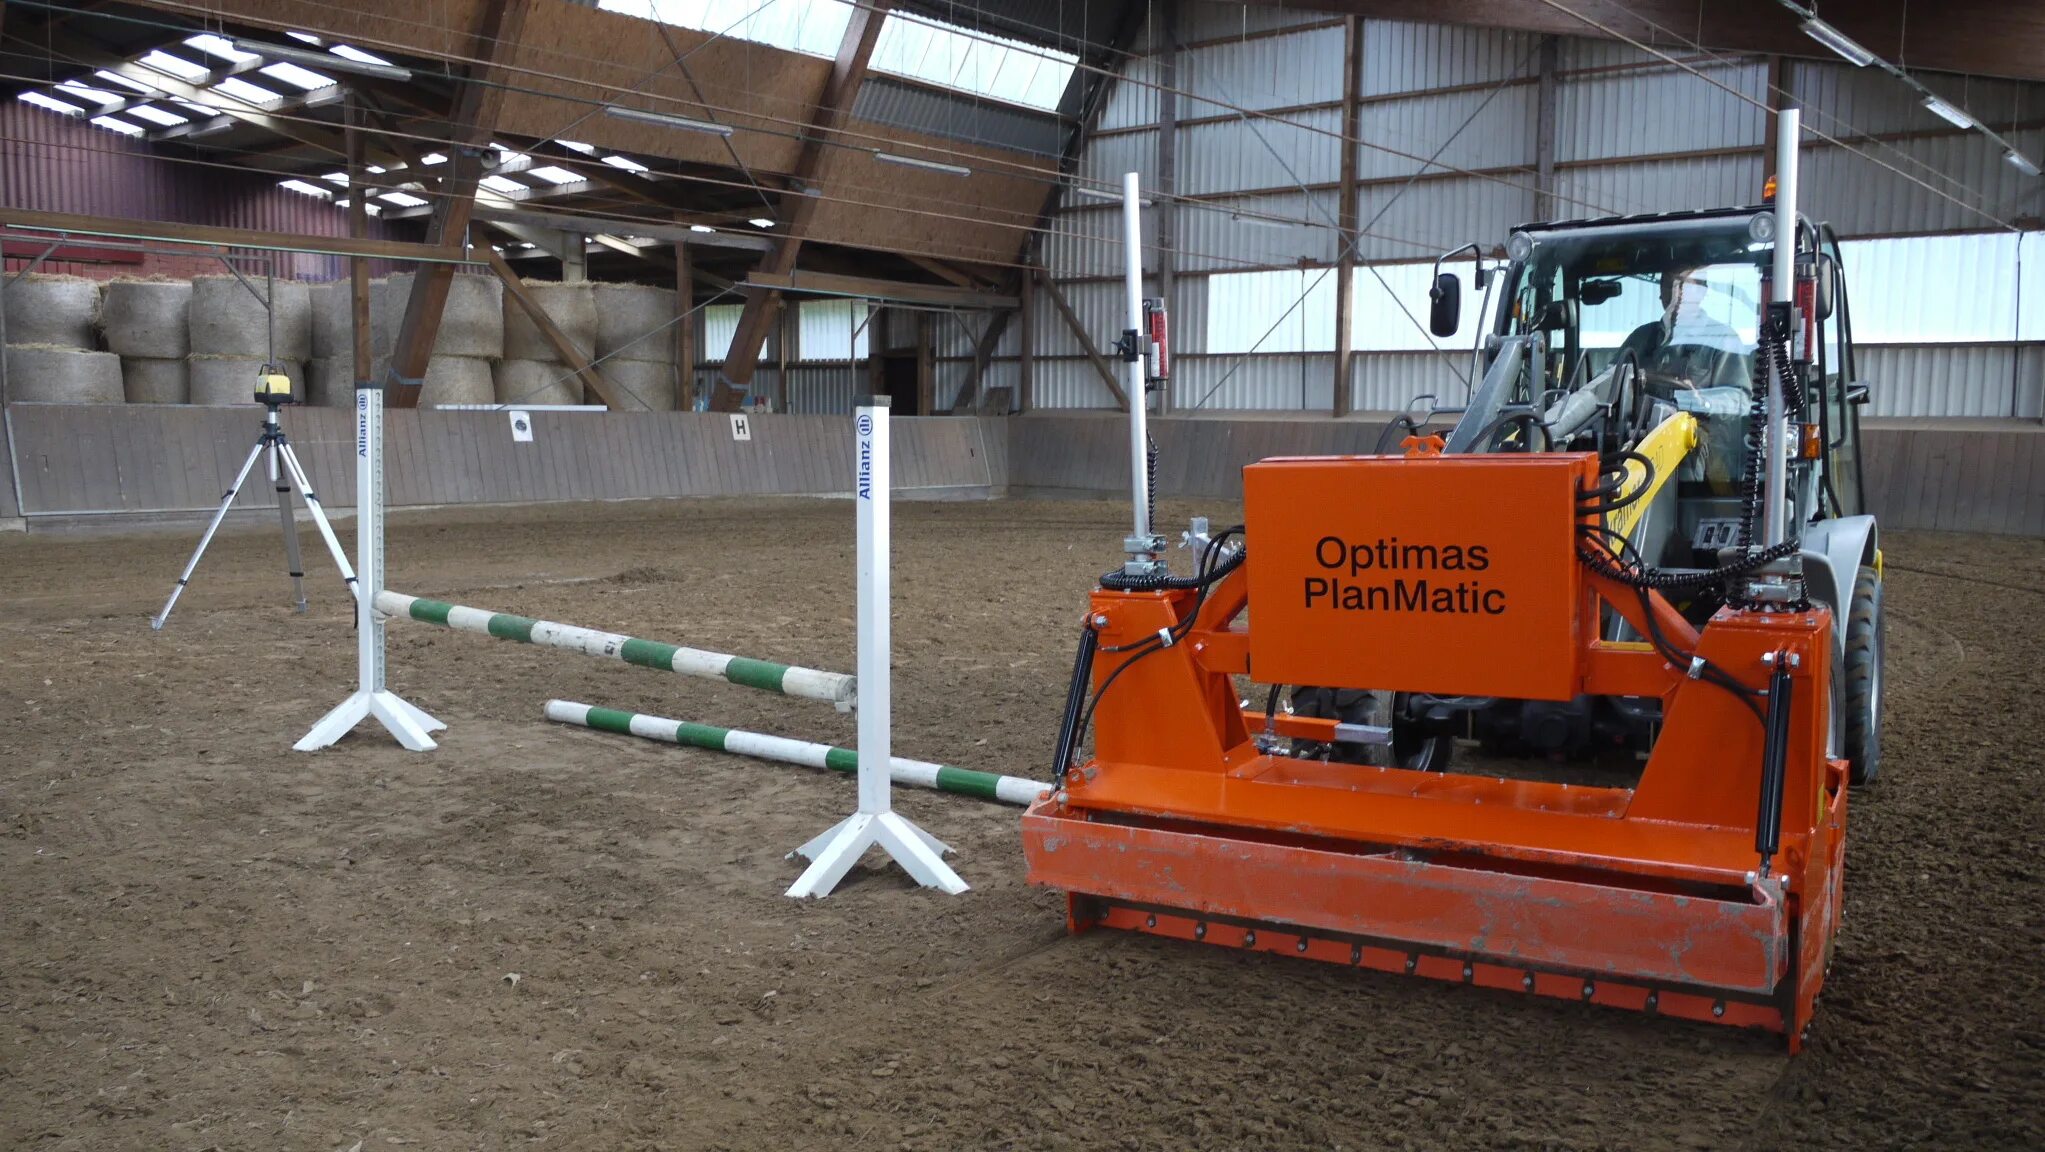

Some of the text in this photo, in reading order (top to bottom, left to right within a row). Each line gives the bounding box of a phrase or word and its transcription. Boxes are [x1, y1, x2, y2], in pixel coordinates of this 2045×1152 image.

[358, 413, 367, 458] Allianz
[735, 419, 746, 435] H
[859, 440, 871, 500] Allianz
[1315, 536, 1490, 577] Optimas
[1304, 577, 1506, 615] PlanMatic
